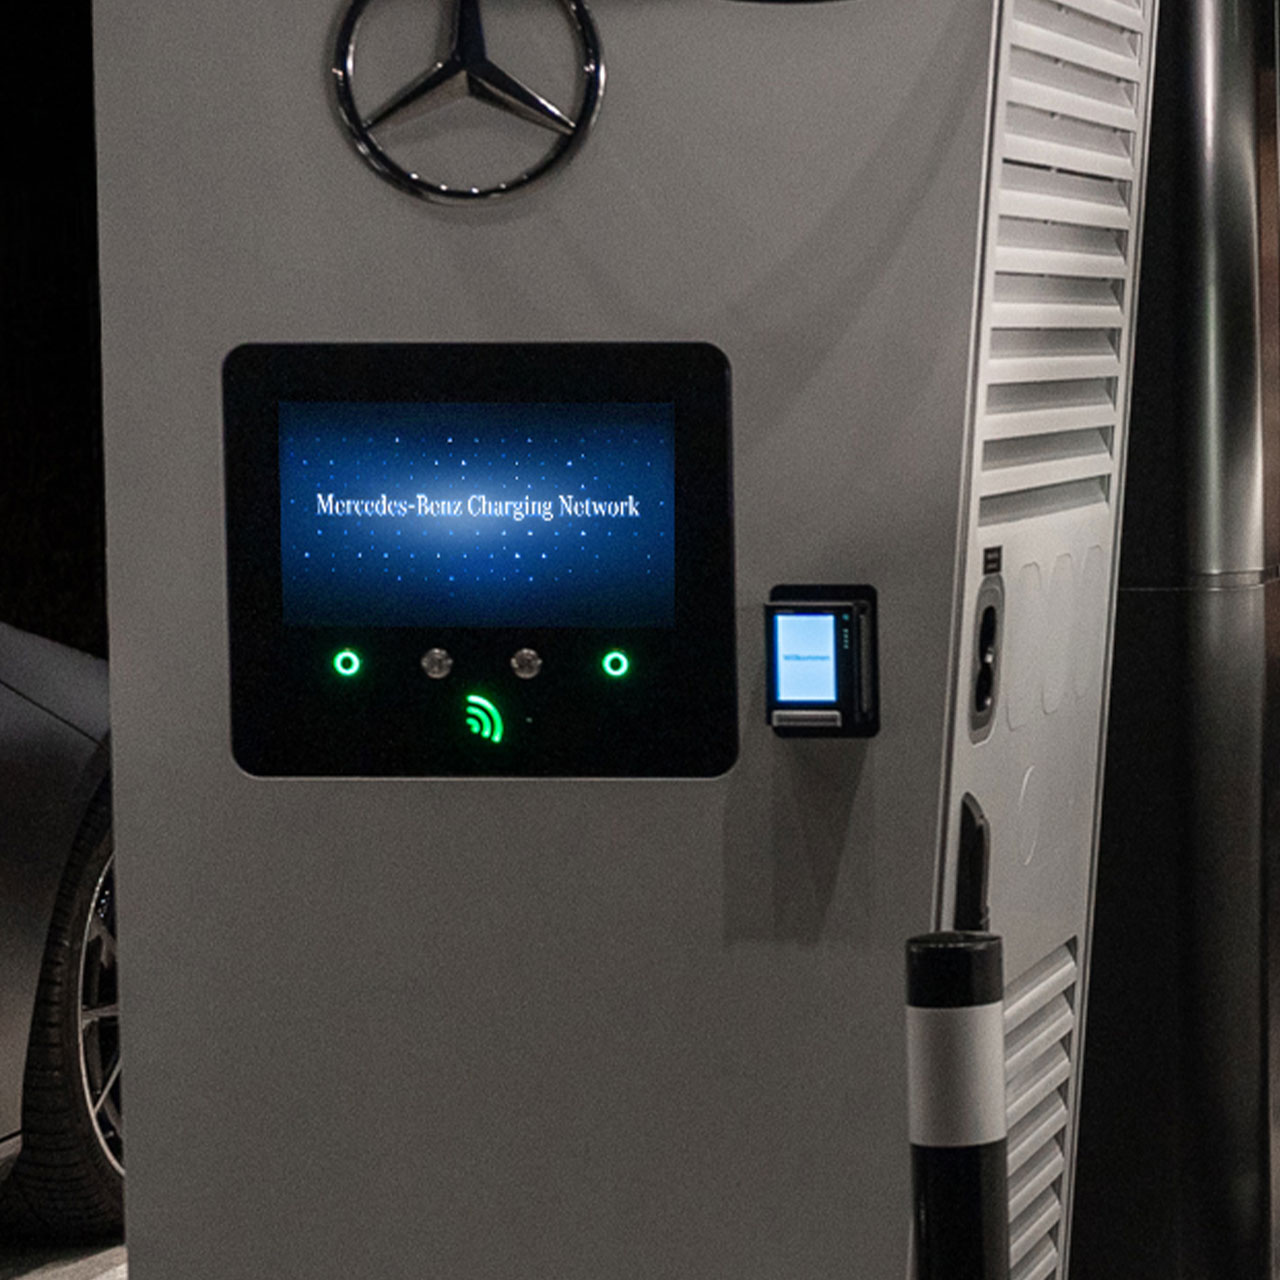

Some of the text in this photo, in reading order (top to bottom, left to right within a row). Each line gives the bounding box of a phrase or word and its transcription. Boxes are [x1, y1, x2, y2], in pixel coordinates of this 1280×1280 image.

[317, 493, 640, 521] Mercedes-Benz Charging Network
